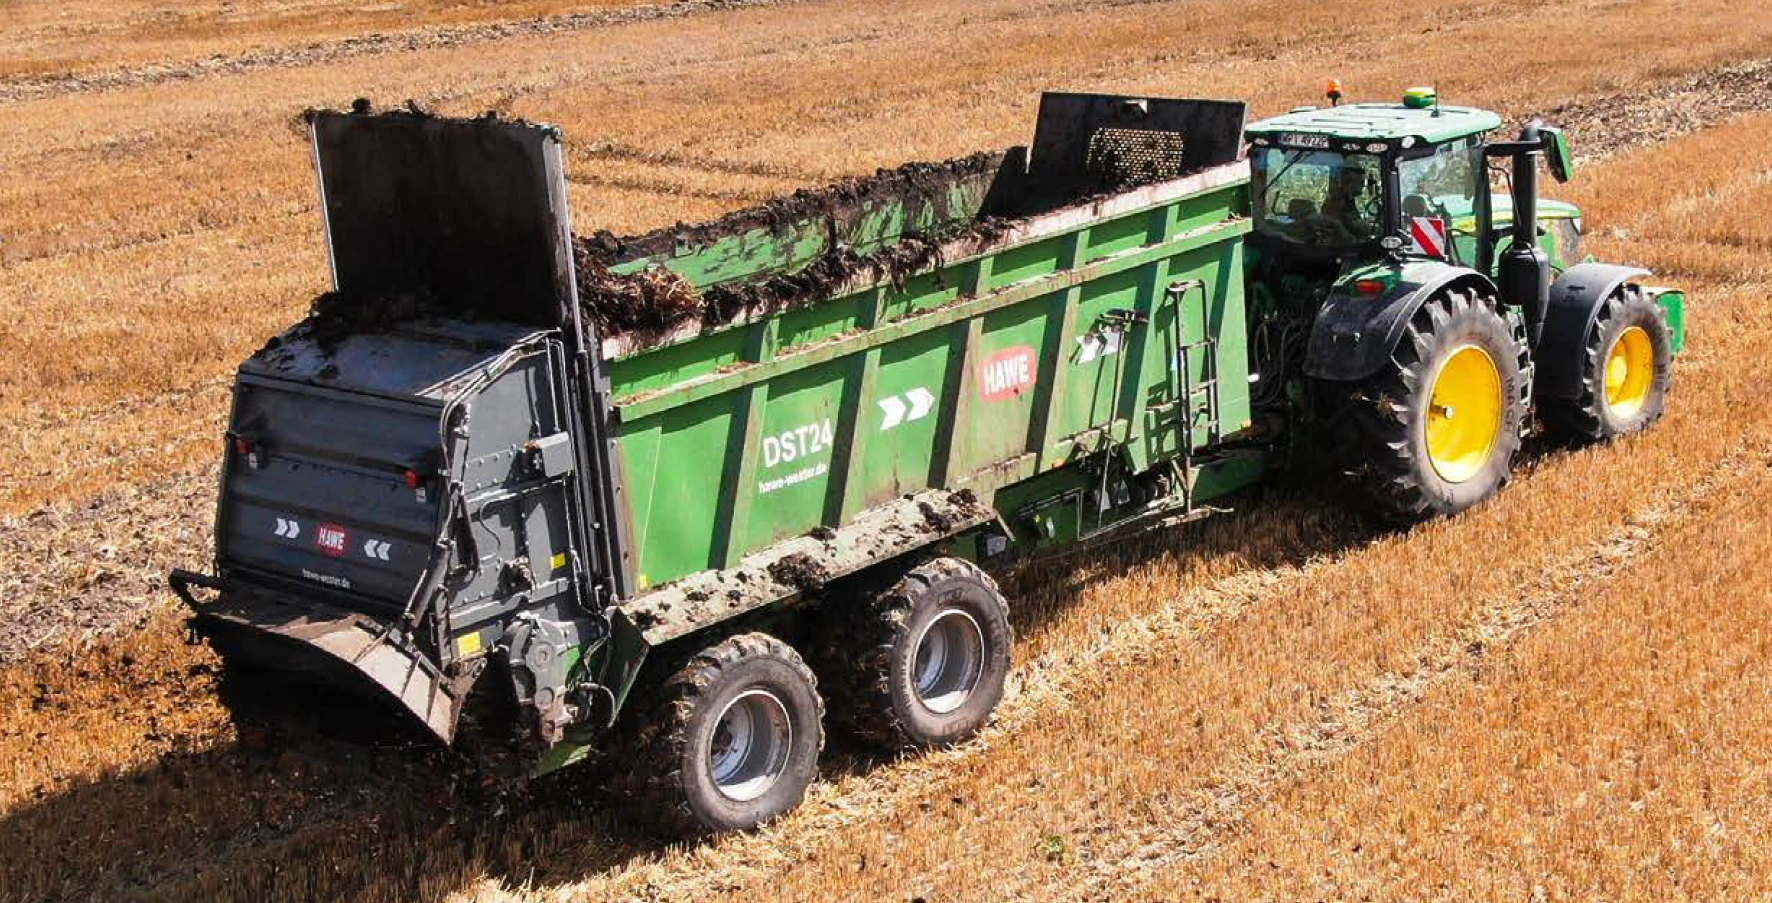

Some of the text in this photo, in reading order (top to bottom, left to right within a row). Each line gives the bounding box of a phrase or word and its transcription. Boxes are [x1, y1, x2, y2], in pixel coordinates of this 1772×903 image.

[983, 353, 1028, 396] HAWE
[763, 418, 833, 468] DST24
[318, 527, 345, 550] HAWE
